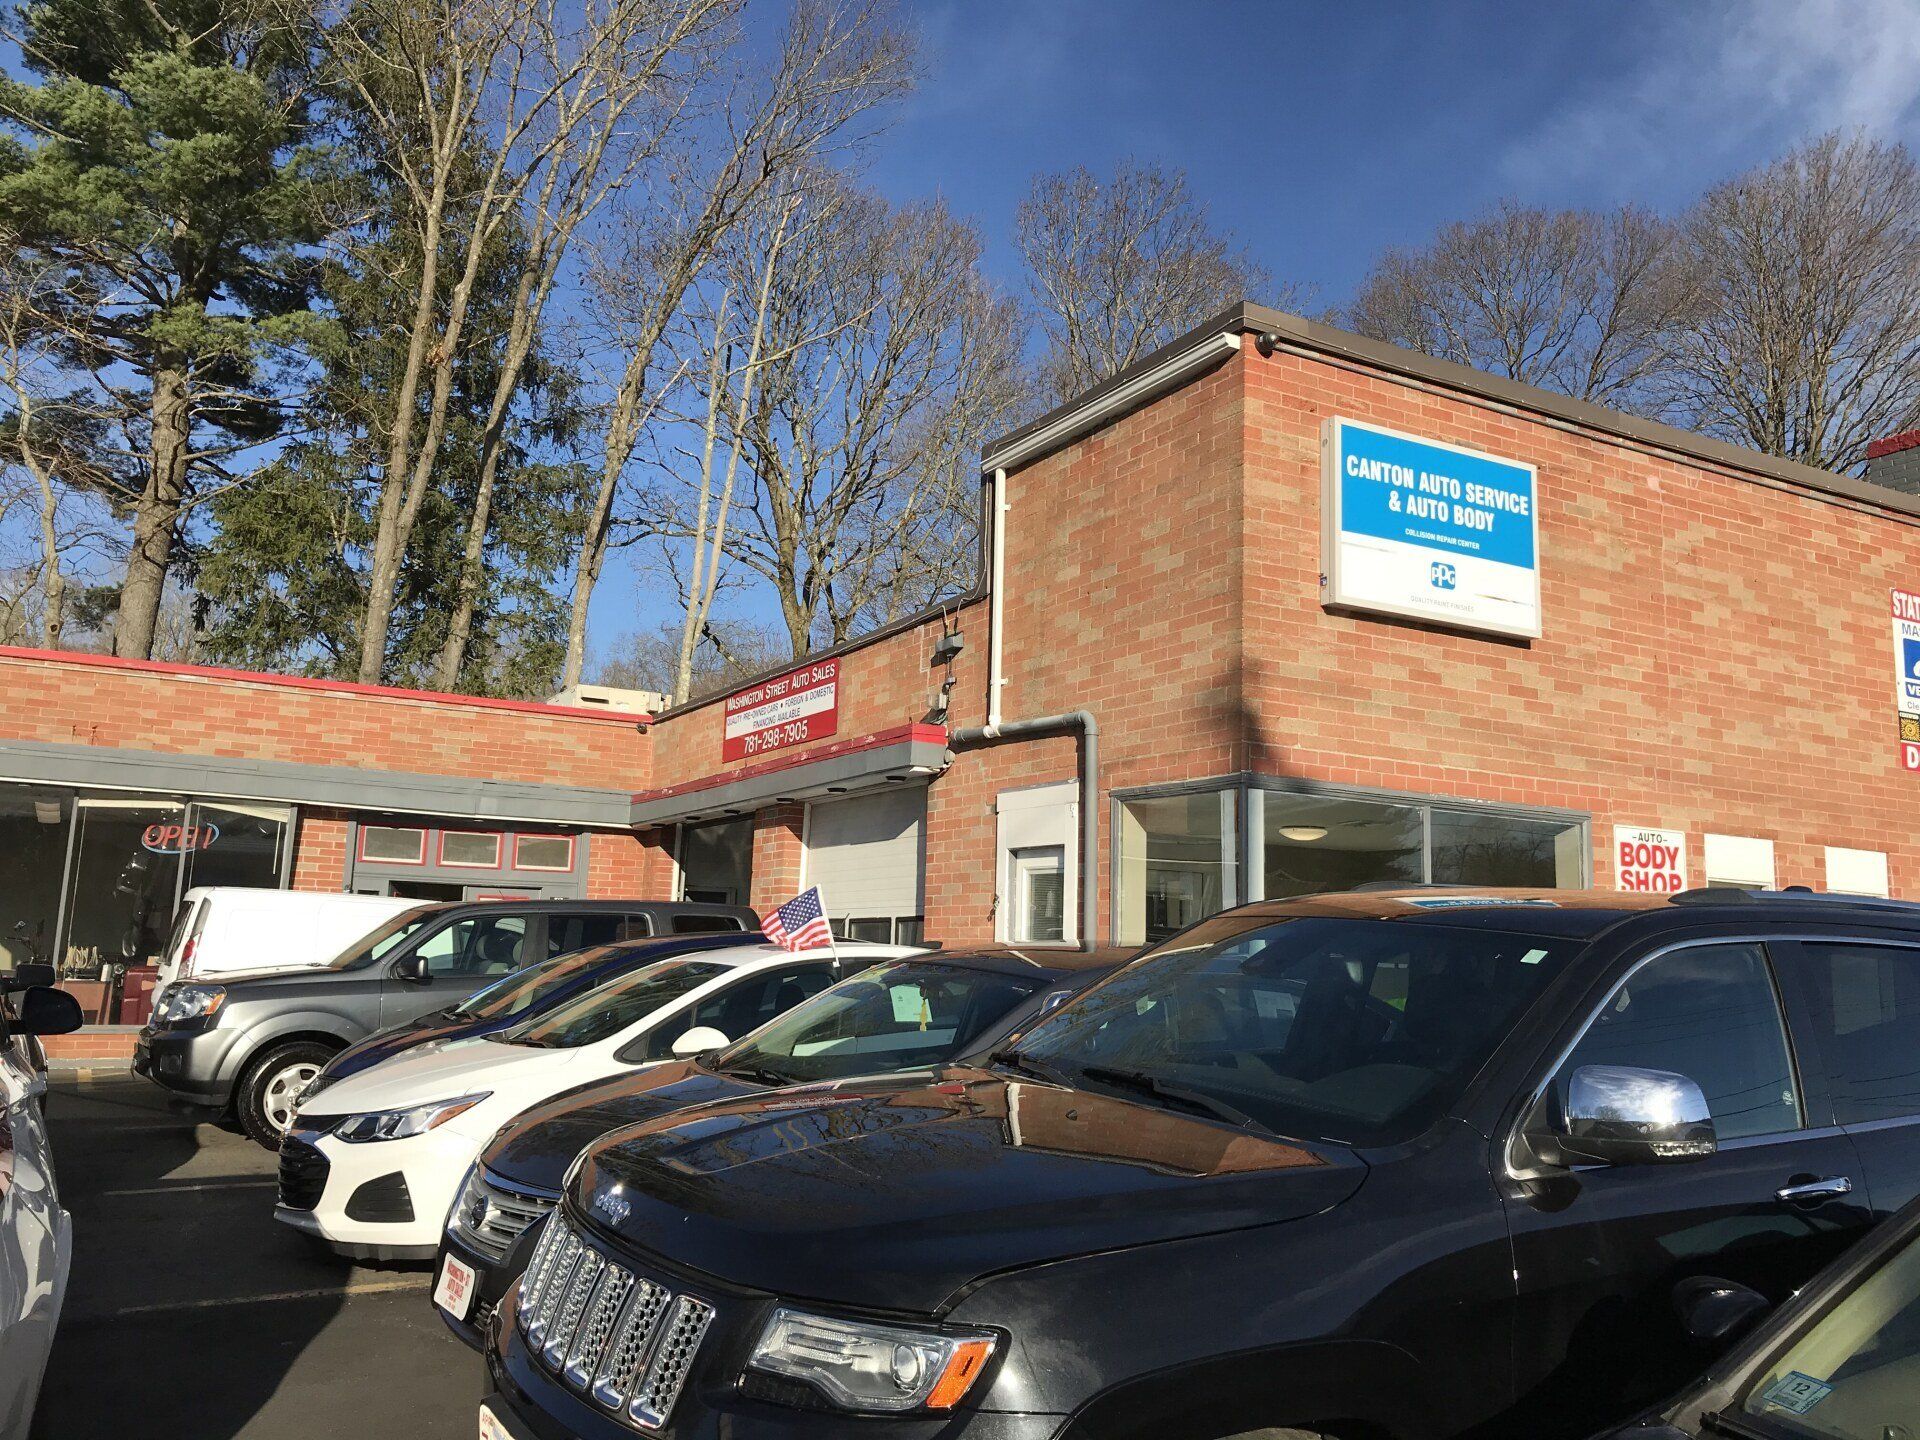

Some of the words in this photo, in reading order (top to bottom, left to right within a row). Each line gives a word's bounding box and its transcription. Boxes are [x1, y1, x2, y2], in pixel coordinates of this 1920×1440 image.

[1346, 454, 1414, 489] CANTON
[1419, 471, 1461, 500] AUTO
[1465, 482, 1529, 516] SERVICE
[1388, 490, 1402, 512] &
[1406, 494, 1449, 523] AUTO
[1453, 504, 1495, 532] BODY
[1405, 527, 1436, 541] COLLISION
[1436, 534, 1457, 545] REPAIR
[1457, 539, 1480, 550] CENTER
[1431, 564, 1456, 587] PPG
[1902, 622, 1920, 637] MA
[727, 689, 764, 712] WASHINGTON
[765, 680, 790, 700] STREET
[791, 672, 810, 690] AUTO
[811, 663, 836, 683] SALES
[784, 695, 805, 708] FOREIGN
[809, 685, 835, 700] DOMESTIC
[744, 720, 808, 754] 781-298-7905
[1620, 842, 1680, 871] BODY
[1620, 869, 1683, 893] SHOP
[1791, 1382, 1811, 1396] 12
